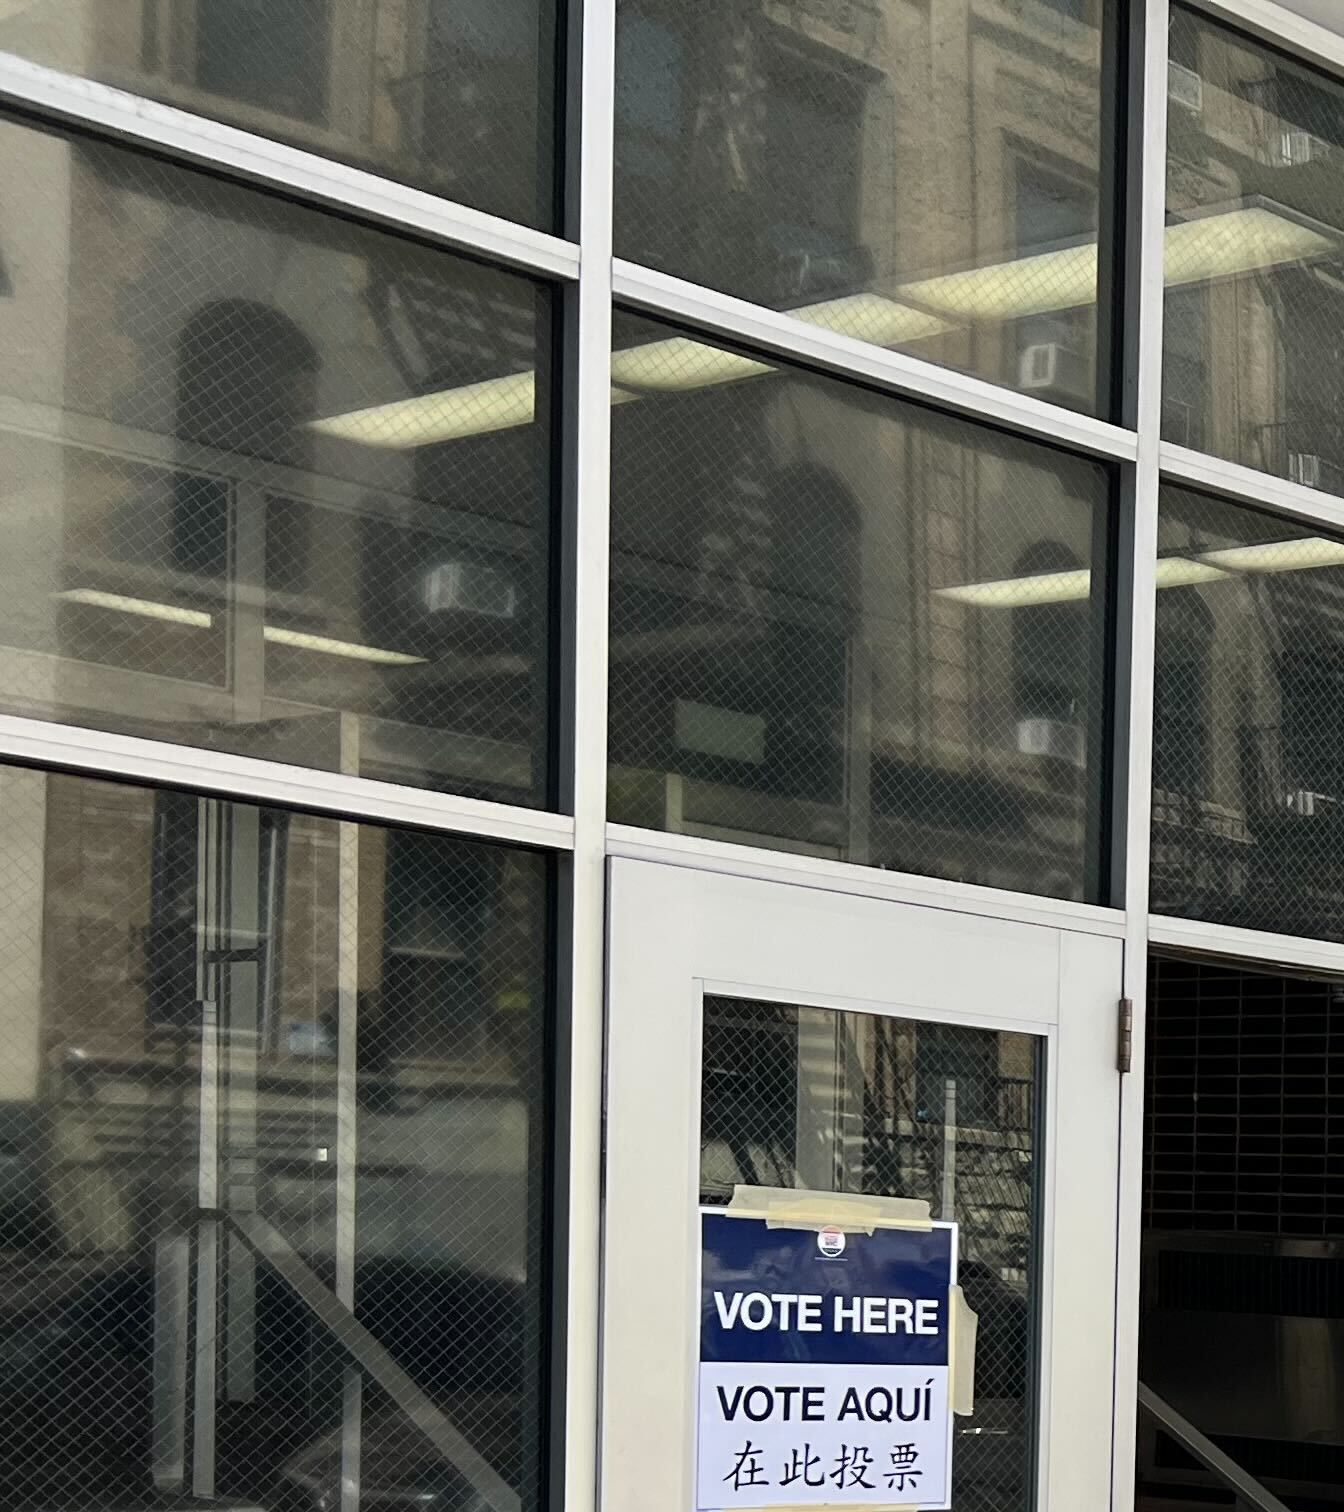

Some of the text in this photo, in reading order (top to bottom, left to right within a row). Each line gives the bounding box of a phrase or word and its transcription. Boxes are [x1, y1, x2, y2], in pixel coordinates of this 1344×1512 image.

[713, 1291, 939, 1335] VOTE HERE
[716, 1378, 935, 1423] VOTE AQUÍ
[722, 1440, 923, 1492] 在此投票
